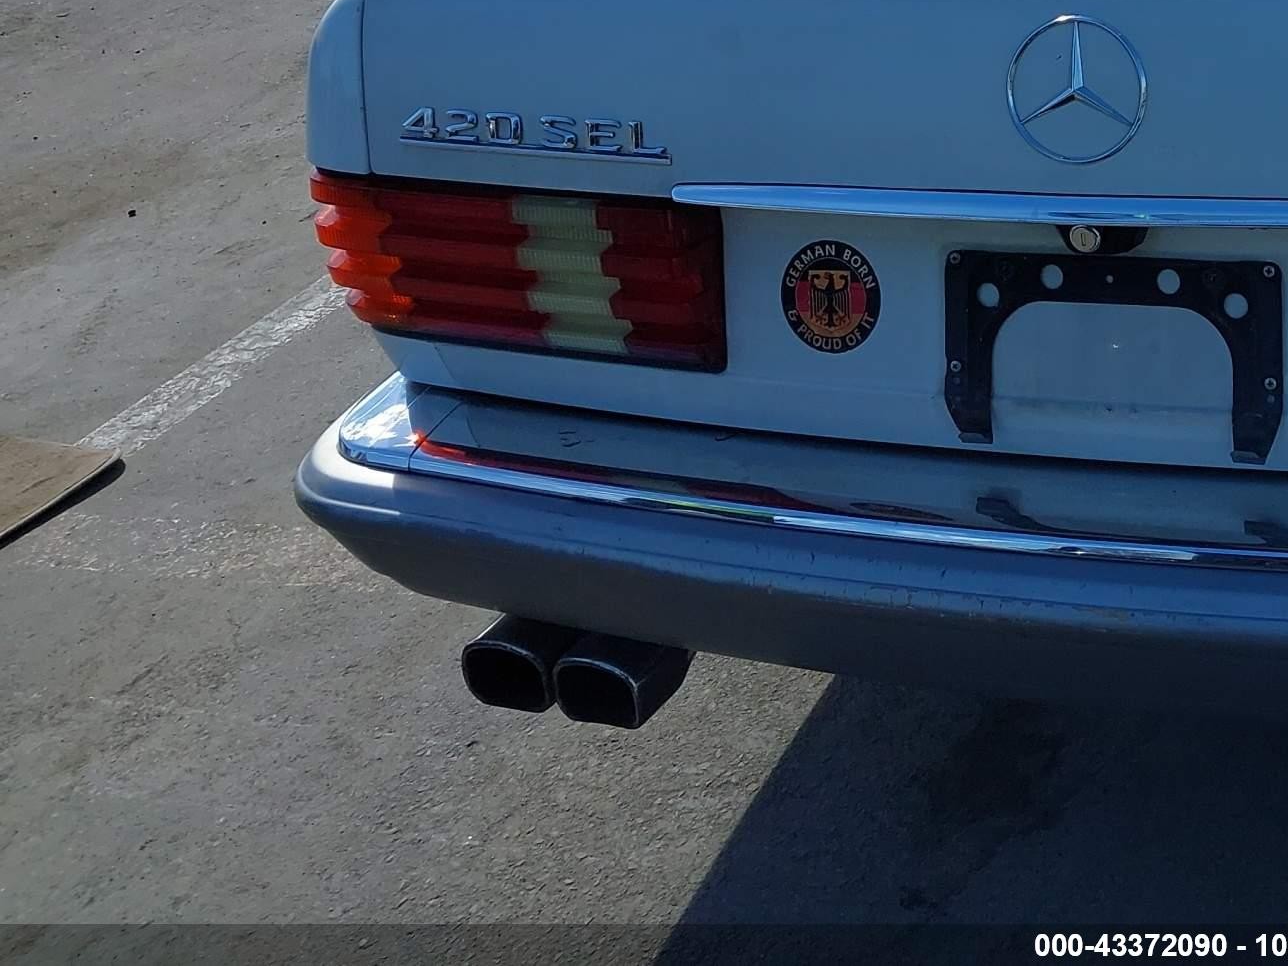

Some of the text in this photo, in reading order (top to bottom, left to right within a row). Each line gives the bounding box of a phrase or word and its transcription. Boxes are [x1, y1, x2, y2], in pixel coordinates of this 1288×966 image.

[401, 106, 667, 155] 420 SEL
[785, 243, 877, 290] GERMAN BORN
[787, 309, 876, 350] & PROUD OF IT
